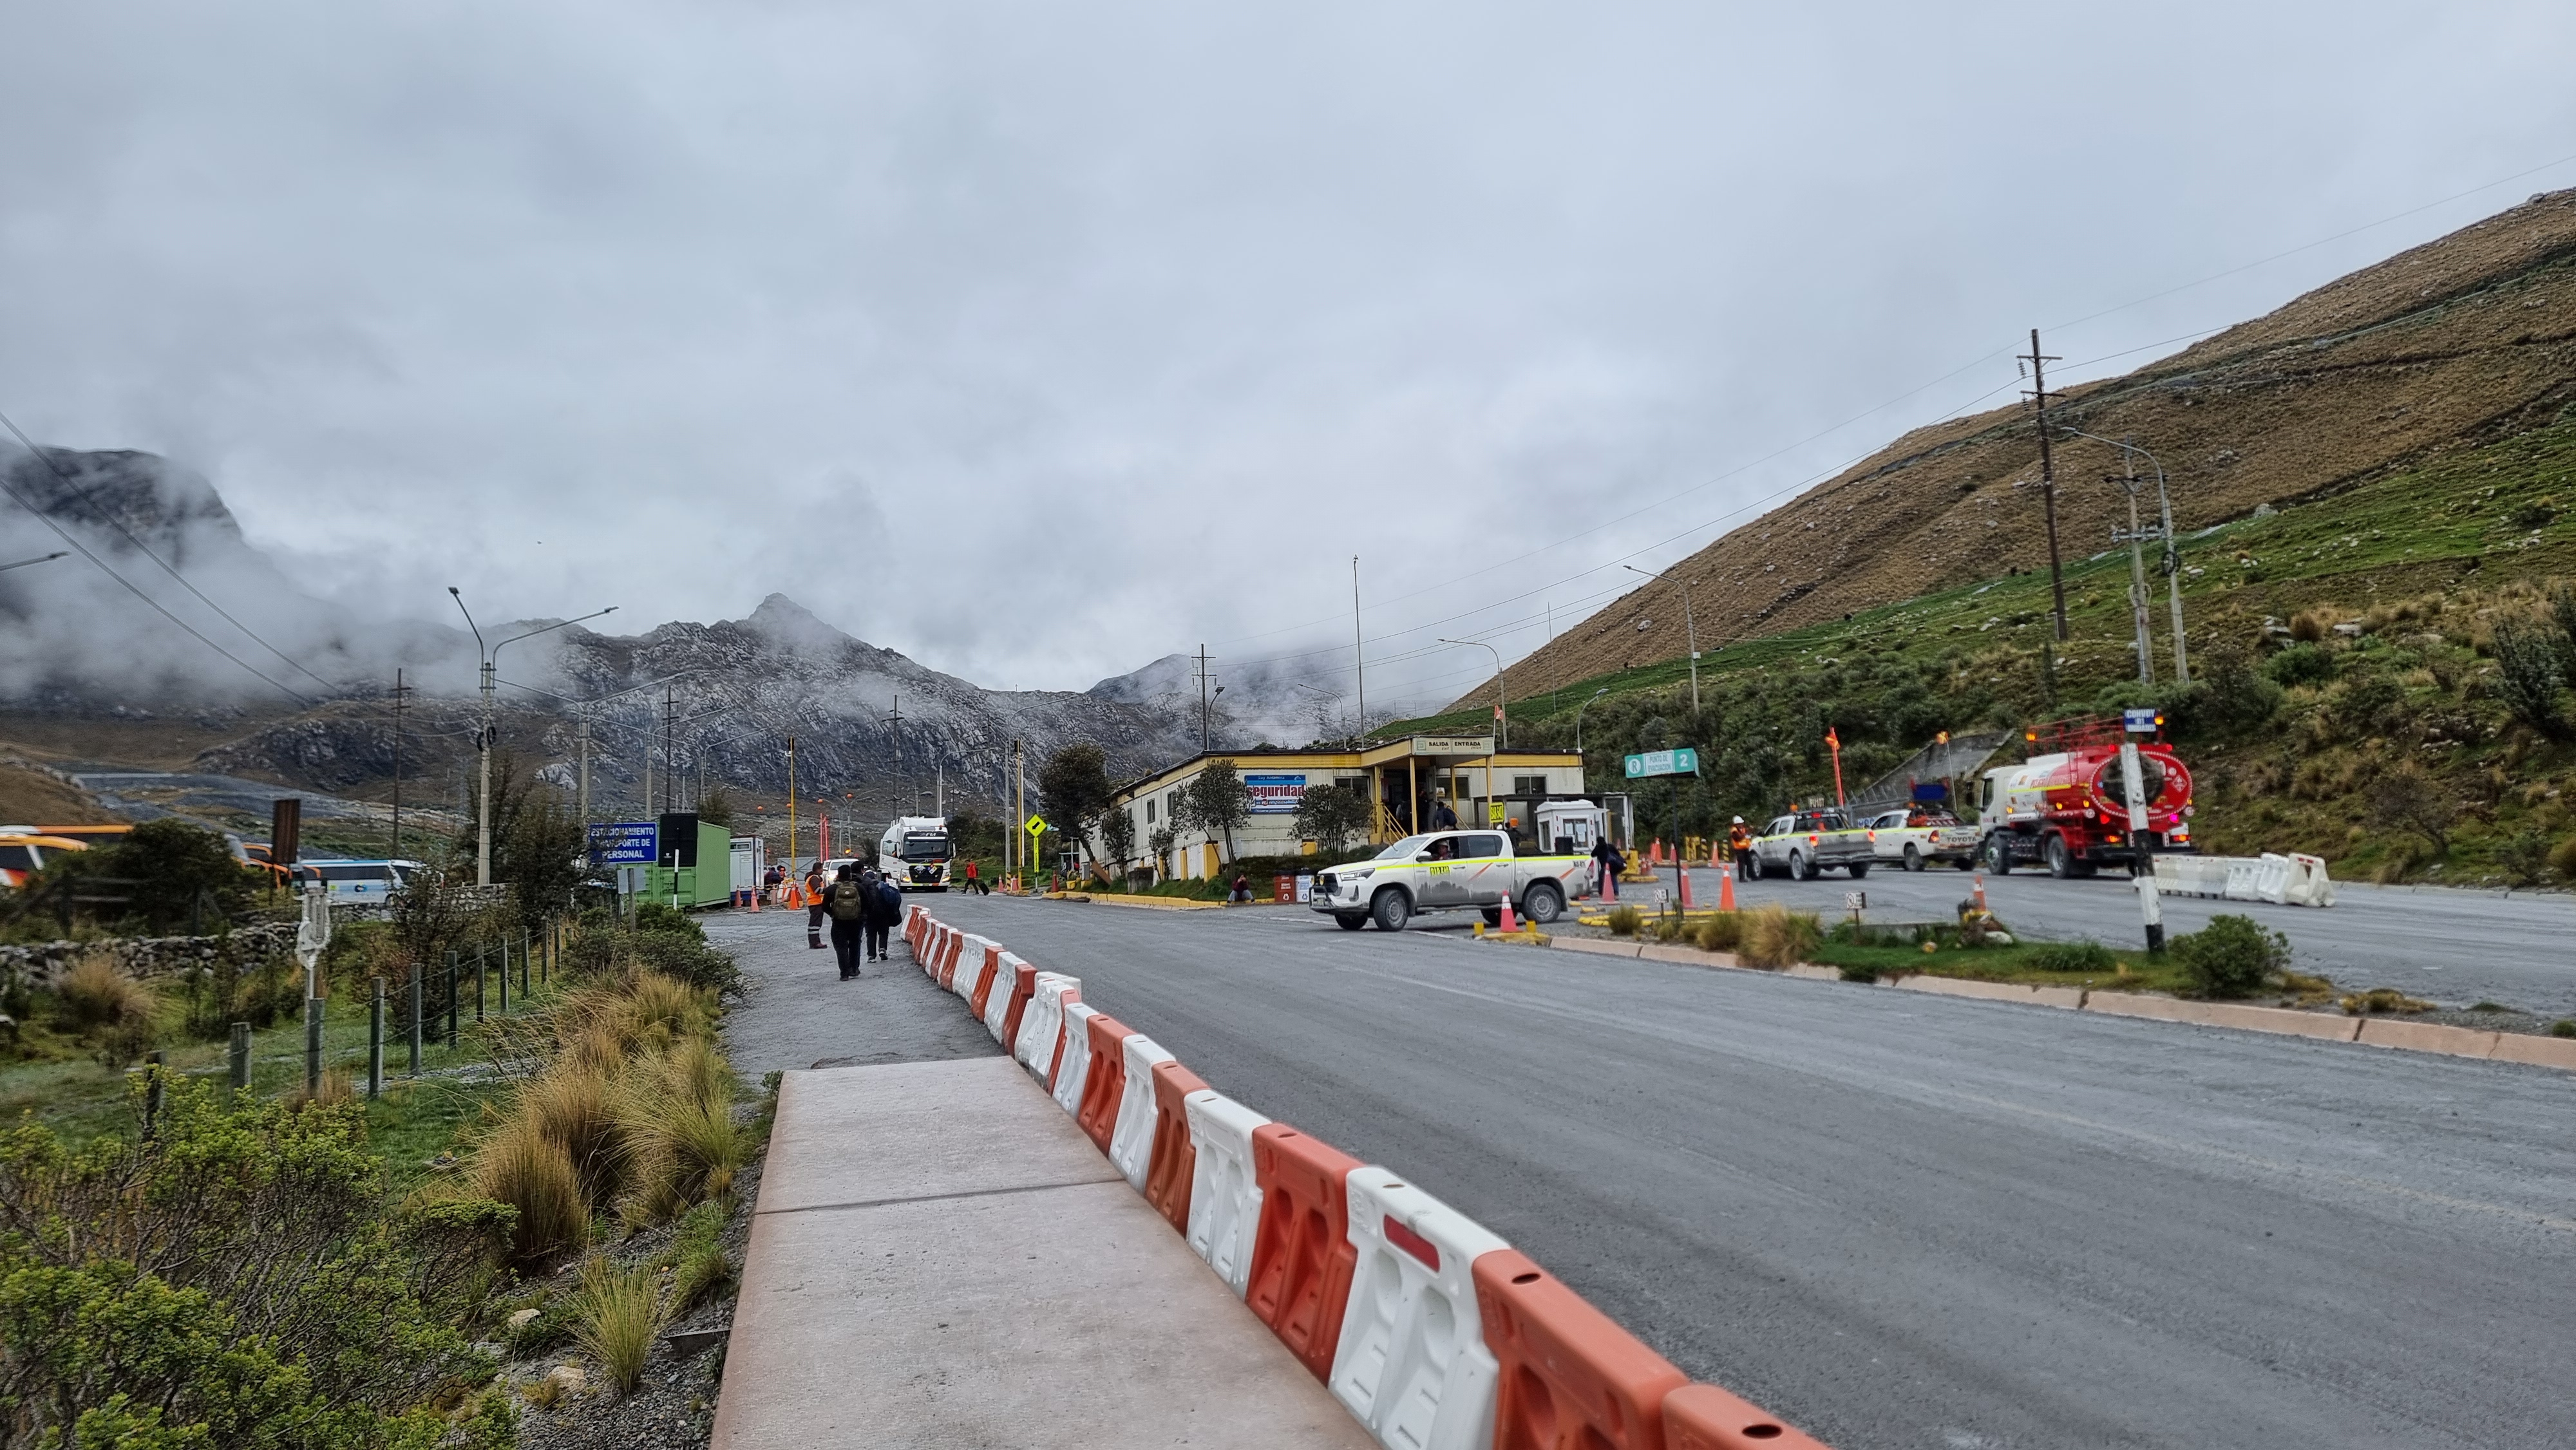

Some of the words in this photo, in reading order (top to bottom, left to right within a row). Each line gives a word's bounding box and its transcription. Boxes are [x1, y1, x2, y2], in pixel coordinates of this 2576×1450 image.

[2126, 709, 2155, 719] CONVOY
[1632, 760, 1638, 772] R
[1680, 754, 1689, 767] 2
[1247, 784, 1305, 798] seguridad
[641, 838, 650, 847] DE
[602, 850, 645, 859] PERSONAL
